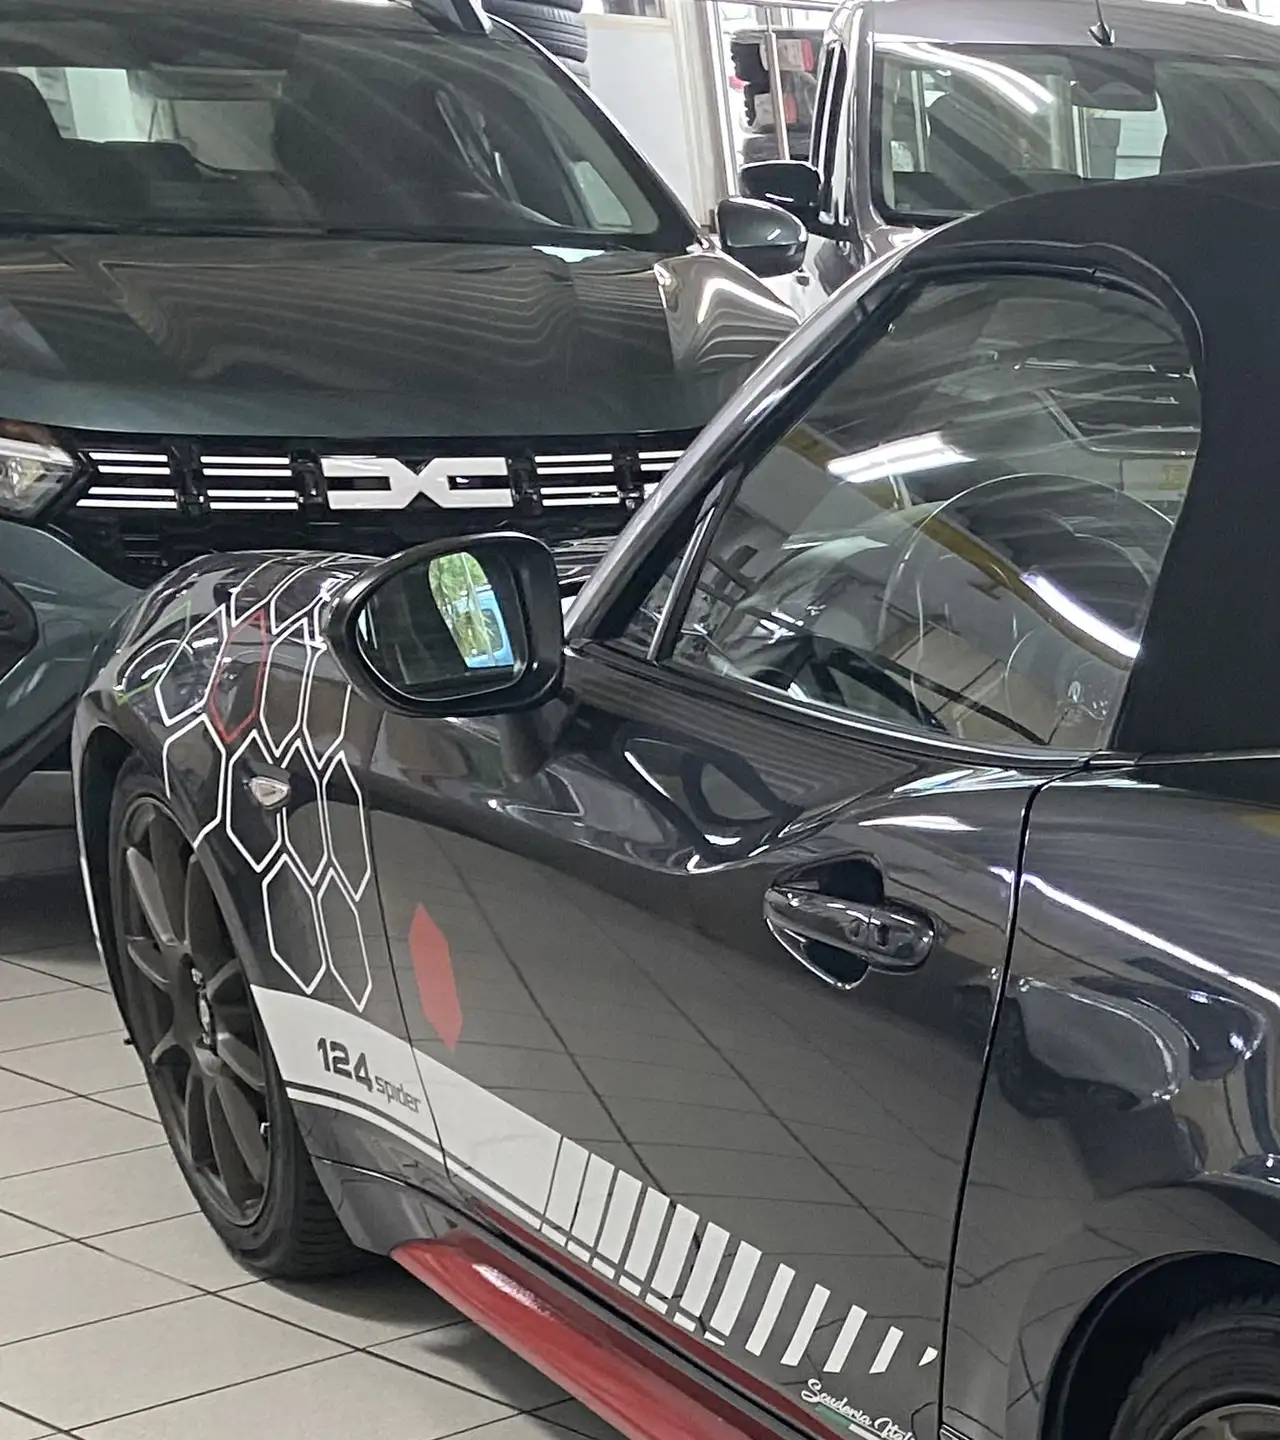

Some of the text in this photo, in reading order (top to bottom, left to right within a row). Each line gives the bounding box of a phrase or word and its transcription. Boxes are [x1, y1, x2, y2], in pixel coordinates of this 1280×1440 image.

[317, 1037, 421, 1113] 124 spider
[801, 1378, 873, 1426] Scuderia
